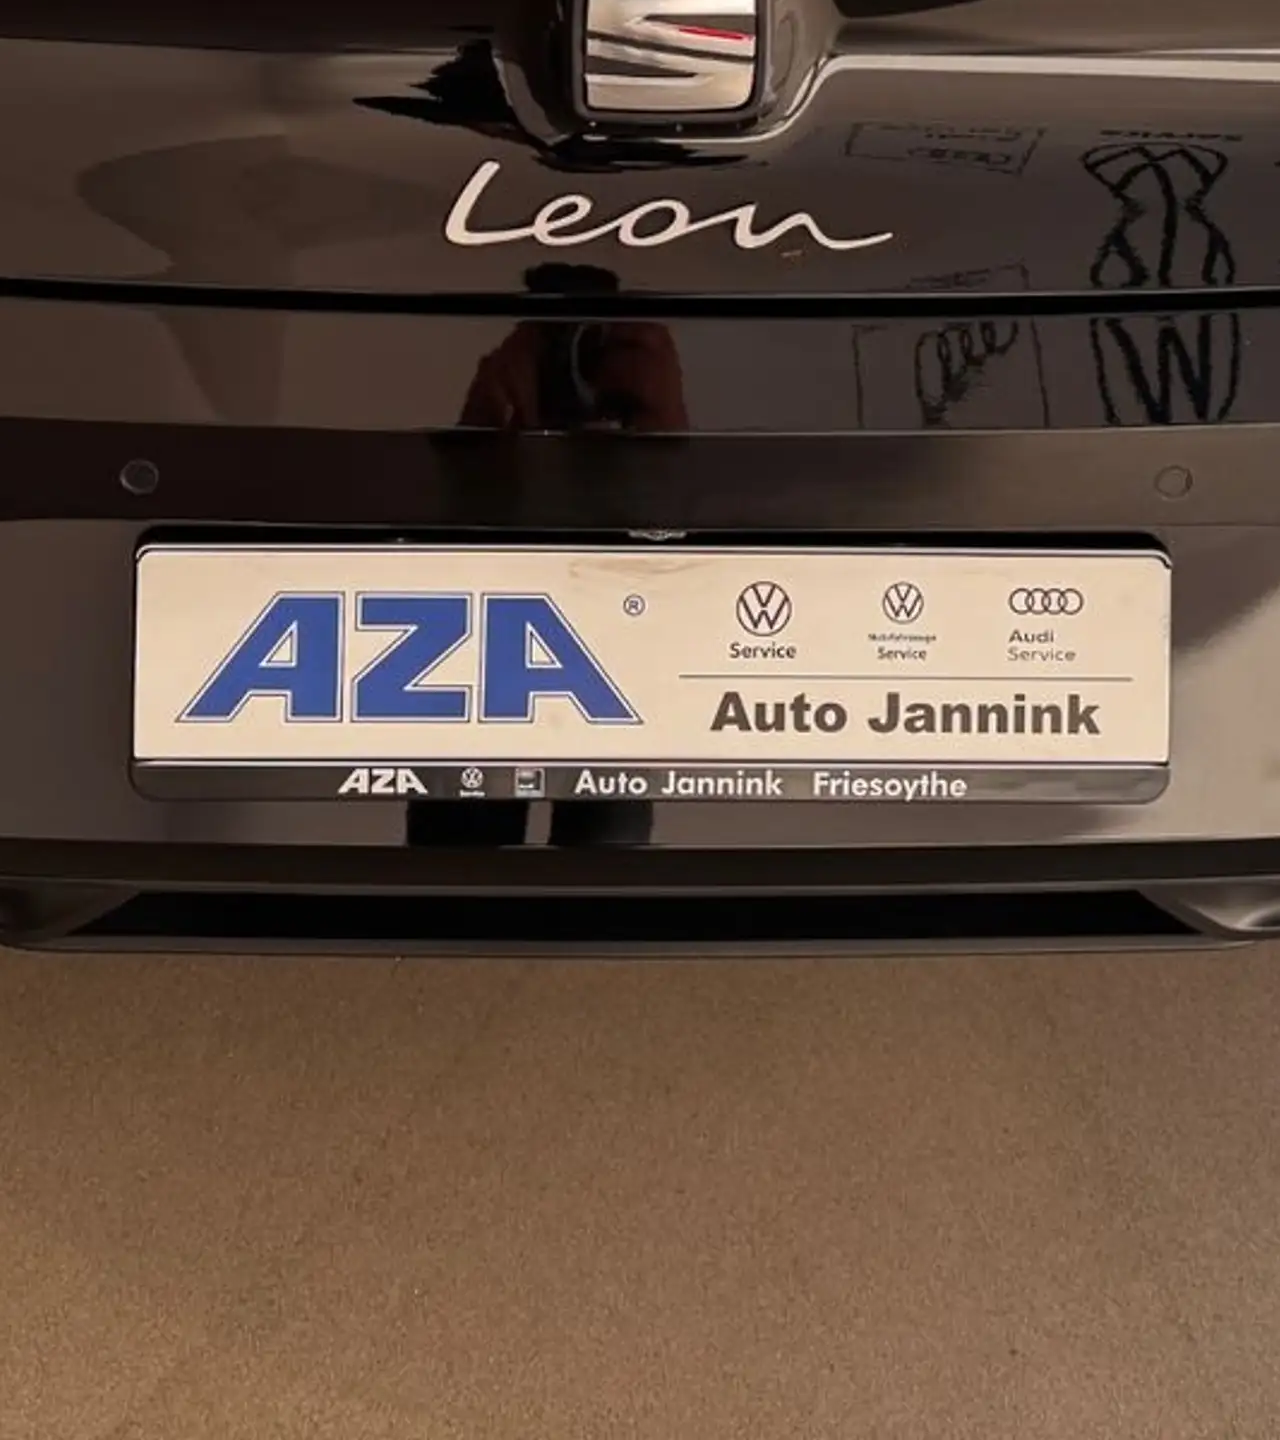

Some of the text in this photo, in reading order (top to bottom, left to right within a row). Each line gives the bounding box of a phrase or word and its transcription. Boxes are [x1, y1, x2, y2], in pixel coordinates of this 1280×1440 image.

[444, 160, 894, 250] Leon
[1008, 628, 1055, 644] Audi
[175, 591, 644, 725] AZA
[729, 641, 797, 660] Service
[877, 646, 928, 661] Service
[1007, 645, 1076, 662] Service
[710, 690, 1101, 735] Auto Jannink
[338, 768, 428, 794] AZA
[575, 769, 648, 795] Auto
[662, 770, 784, 796] Jannink
[813, 771, 968, 801] Friesoythe
